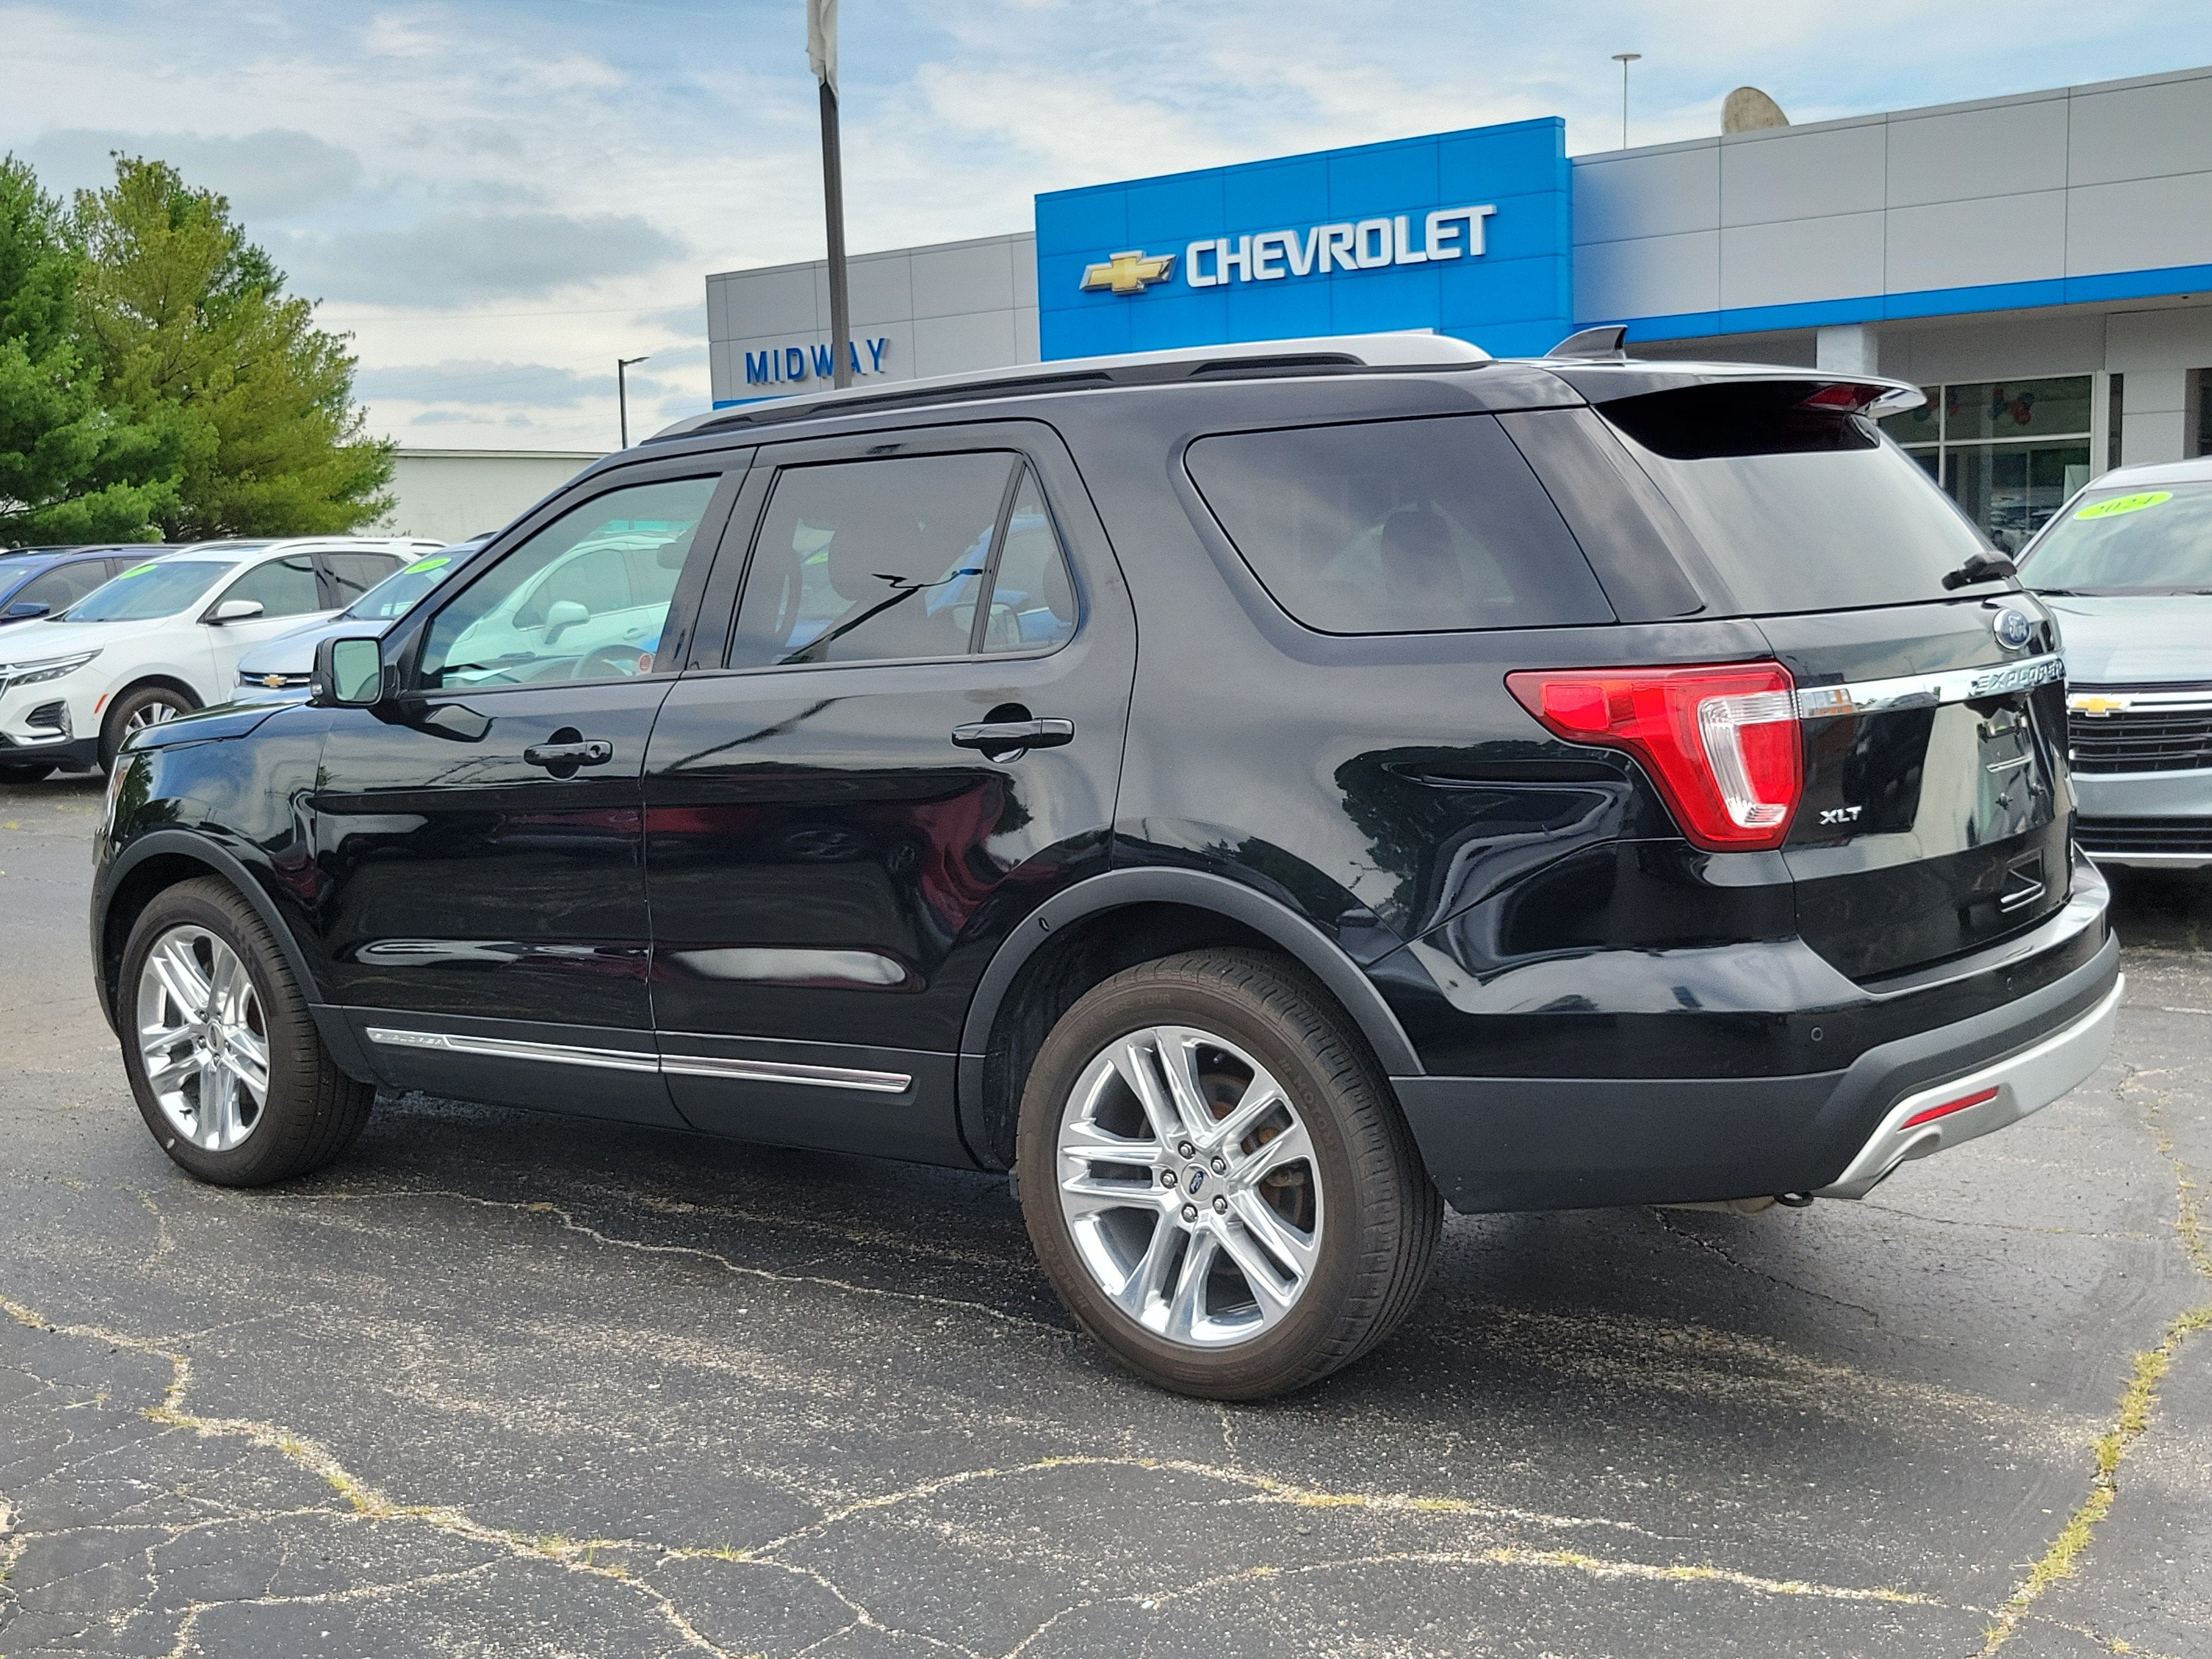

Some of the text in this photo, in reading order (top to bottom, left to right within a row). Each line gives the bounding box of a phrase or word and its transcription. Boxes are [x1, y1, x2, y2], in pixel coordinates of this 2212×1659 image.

[1186, 204, 1497, 287] CHEVROLET
[745, 337, 889, 383] MIDWAY
[1974, 660, 2066, 695] EXPLORER
[1819, 805, 1862, 825] XLT
[1140, 994, 1171, 1006] TOUR
